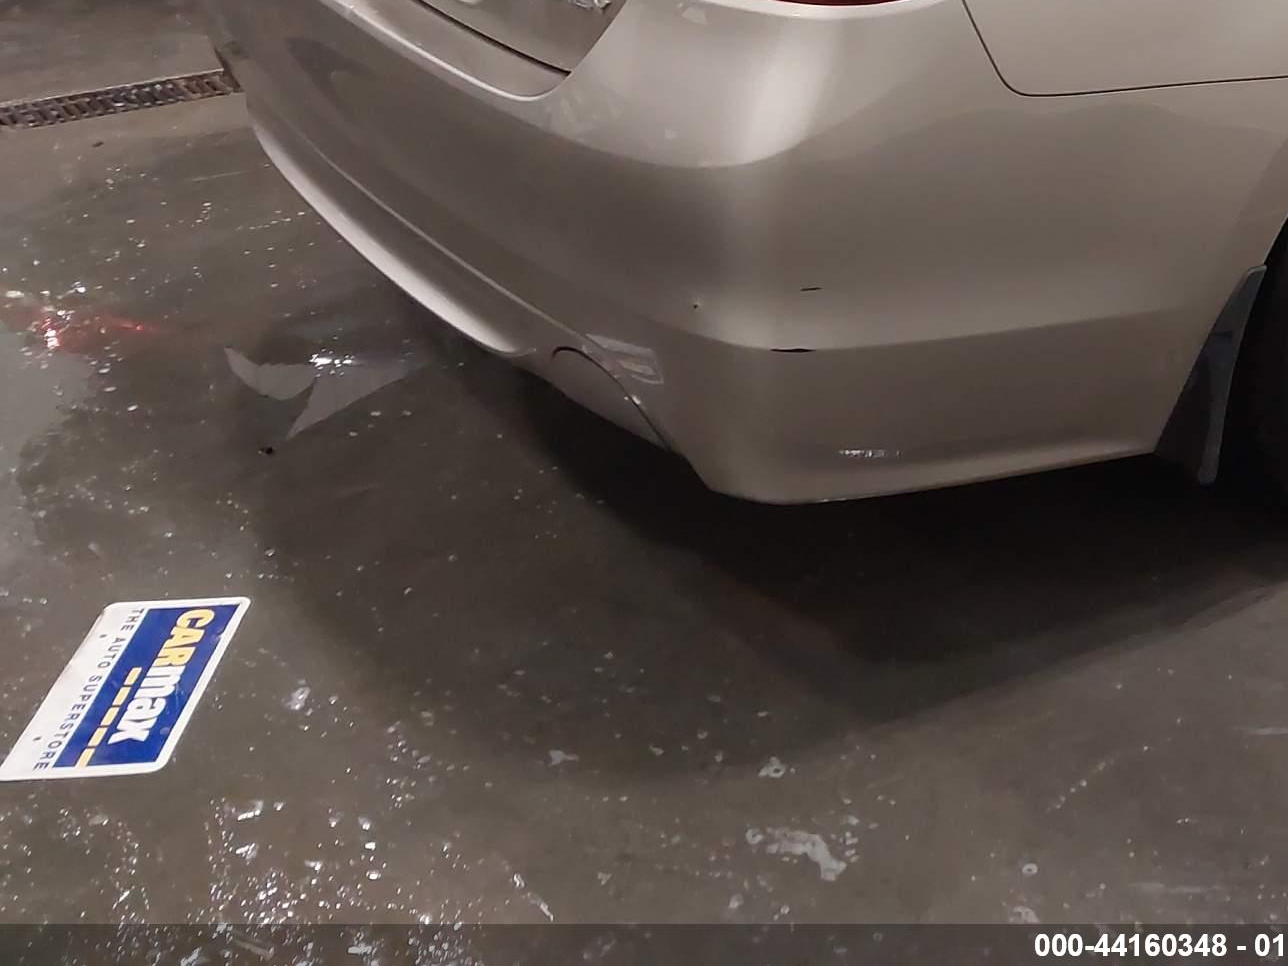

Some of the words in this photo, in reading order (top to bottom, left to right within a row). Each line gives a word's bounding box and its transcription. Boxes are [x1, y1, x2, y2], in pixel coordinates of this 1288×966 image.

[120, 607, 146, 632] THE
[97, 636, 128, 670] AUTO
[33, 674, 103, 771] SUPERSTORE
